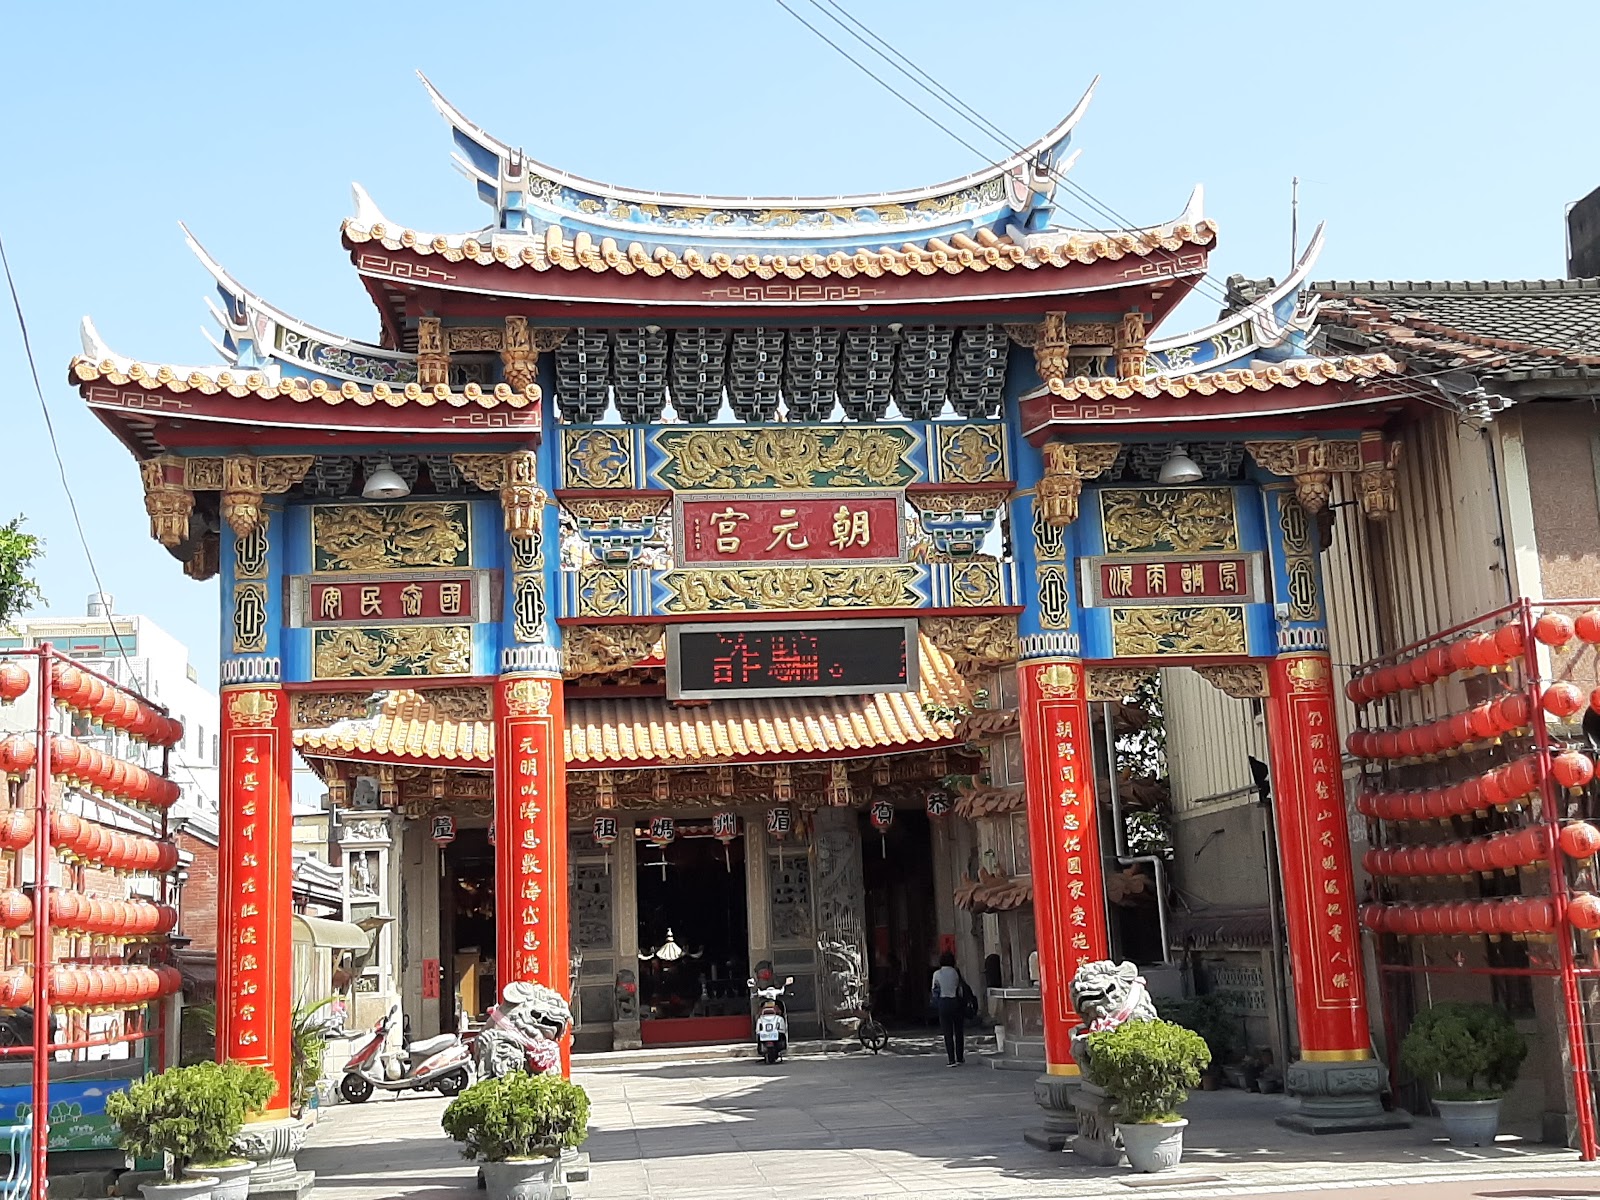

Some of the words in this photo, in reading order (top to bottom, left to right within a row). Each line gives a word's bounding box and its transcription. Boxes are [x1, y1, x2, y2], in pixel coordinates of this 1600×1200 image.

[709, 505, 871, 554] 朝元宮
[1108, 561, 1239, 597] 風調雨順
[320, 583, 462, 619] 國泰民安
